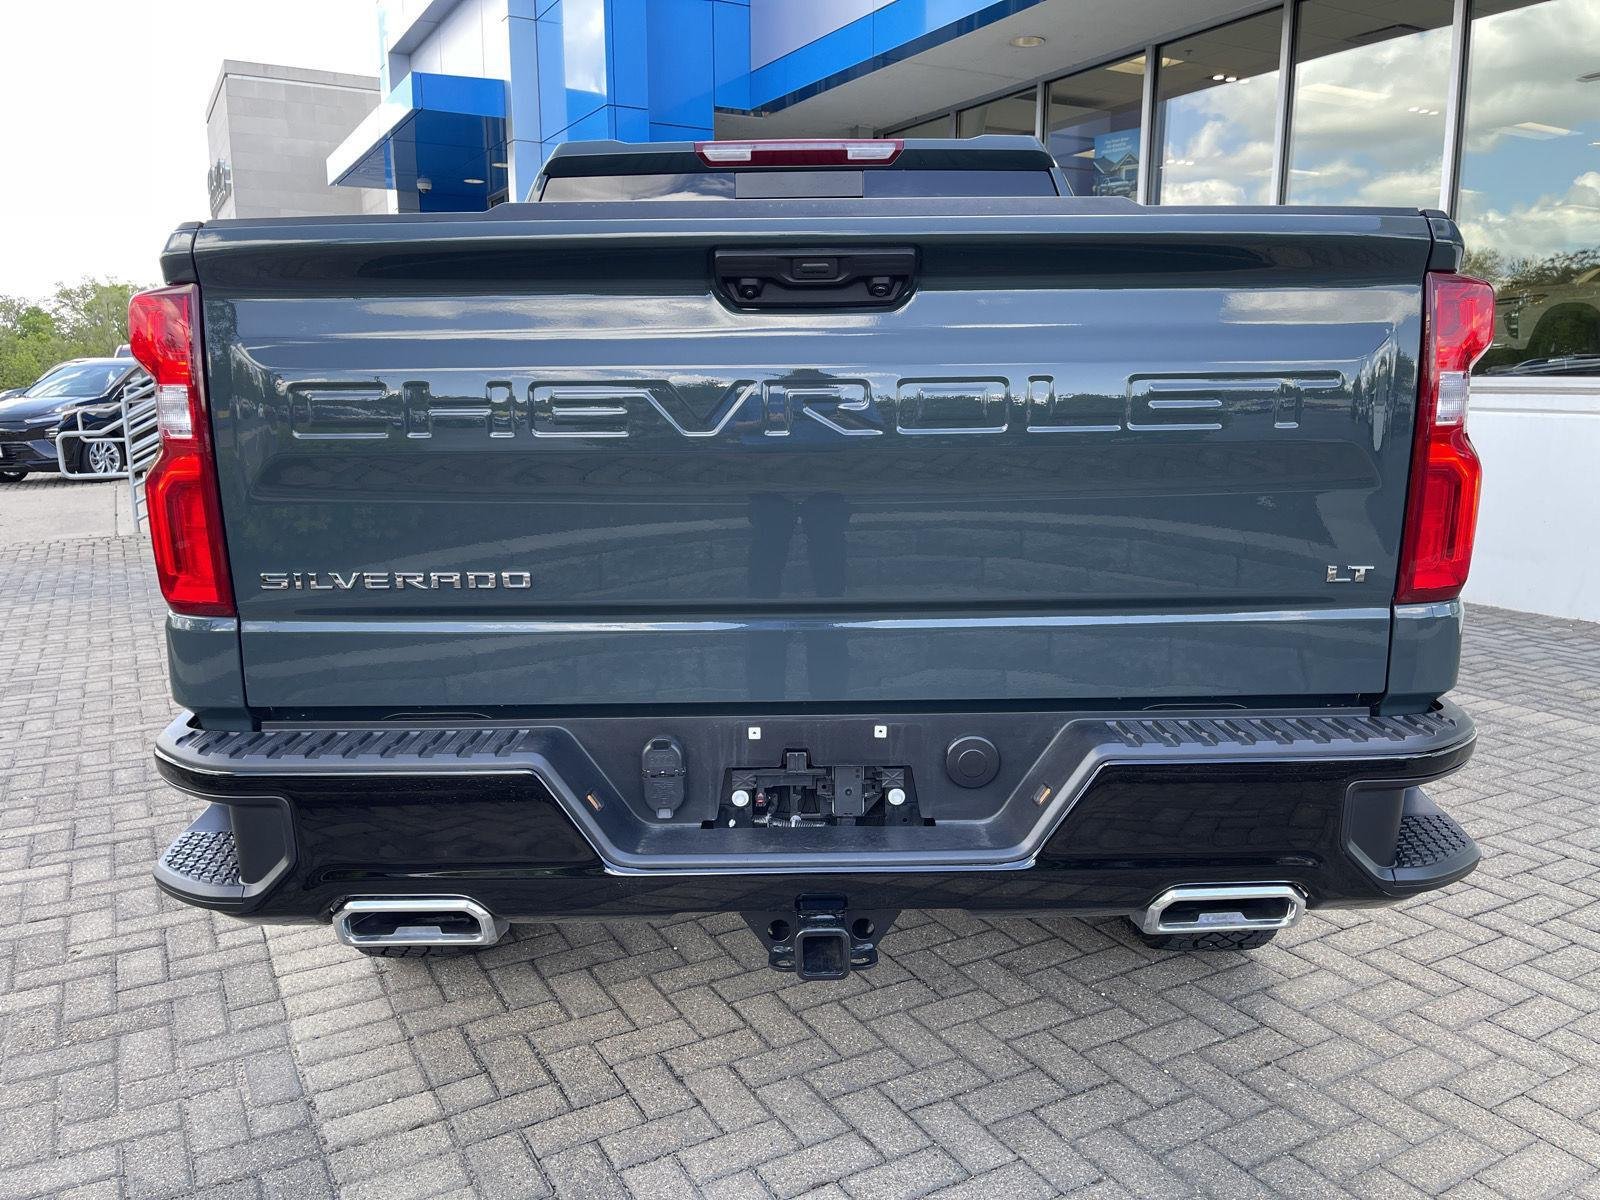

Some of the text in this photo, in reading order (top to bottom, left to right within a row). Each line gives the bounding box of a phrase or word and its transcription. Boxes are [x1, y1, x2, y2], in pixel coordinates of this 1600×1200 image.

[287, 370, 1345, 440] CHEVROLET
[260, 571, 532, 590] SILVERADO
[1327, 565, 1375, 583] LT
